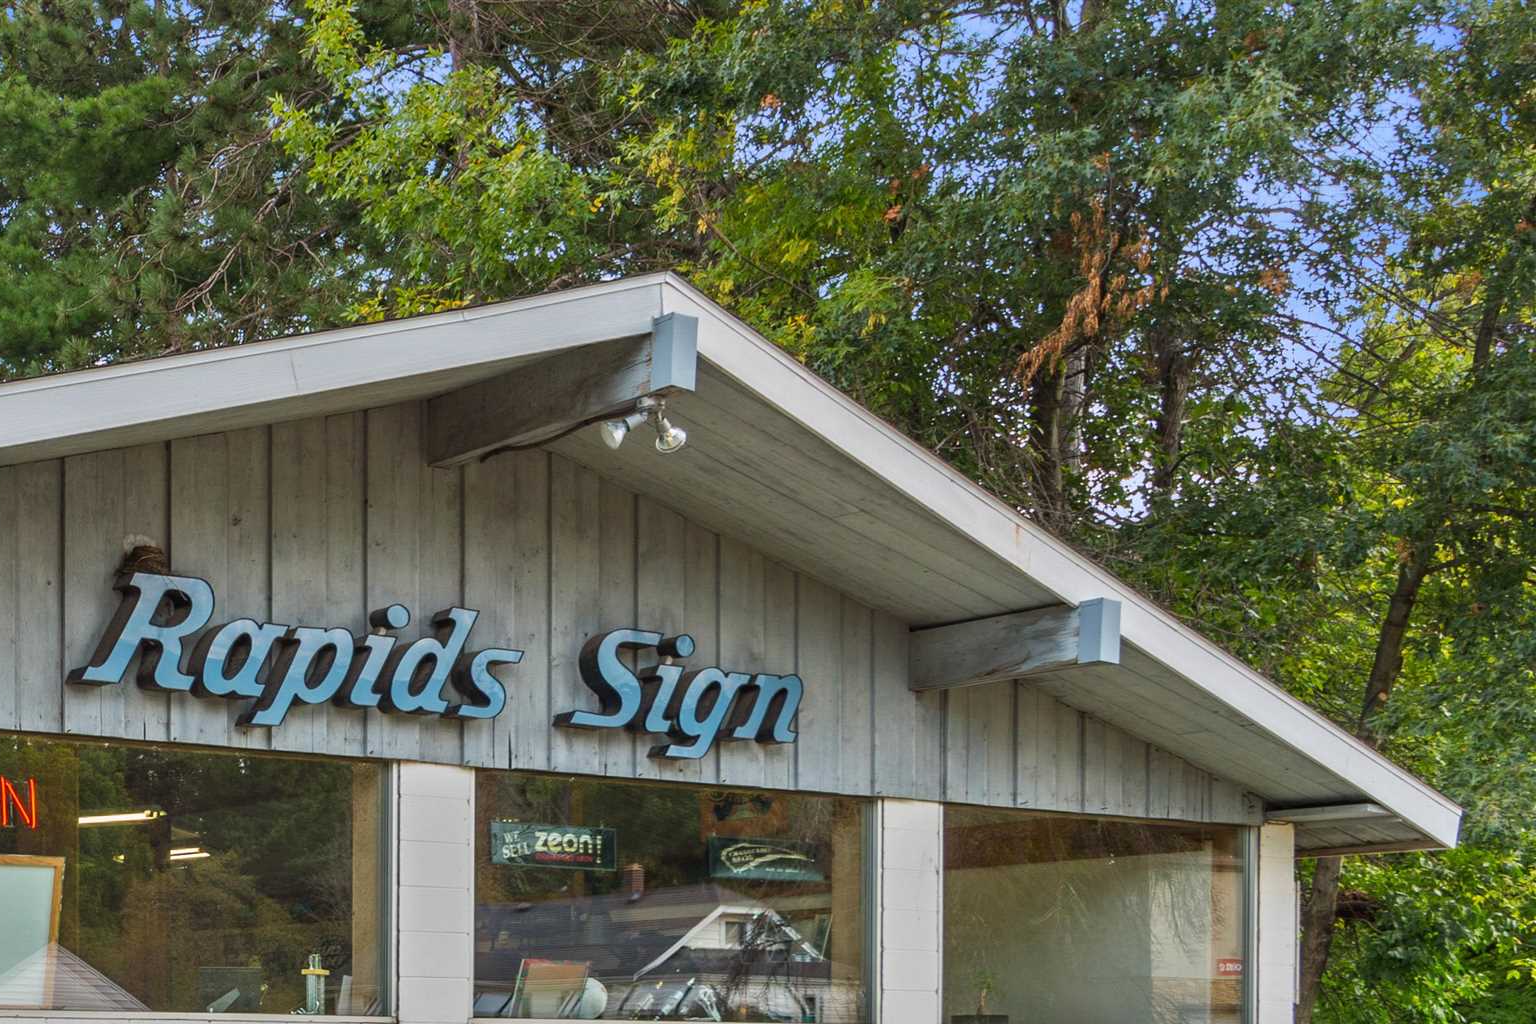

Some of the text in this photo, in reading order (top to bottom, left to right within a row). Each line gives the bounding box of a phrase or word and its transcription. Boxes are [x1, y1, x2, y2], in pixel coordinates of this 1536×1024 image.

[70, 572, 805, 760] Rapids Sign
[502, 842, 531, 858] SELL
